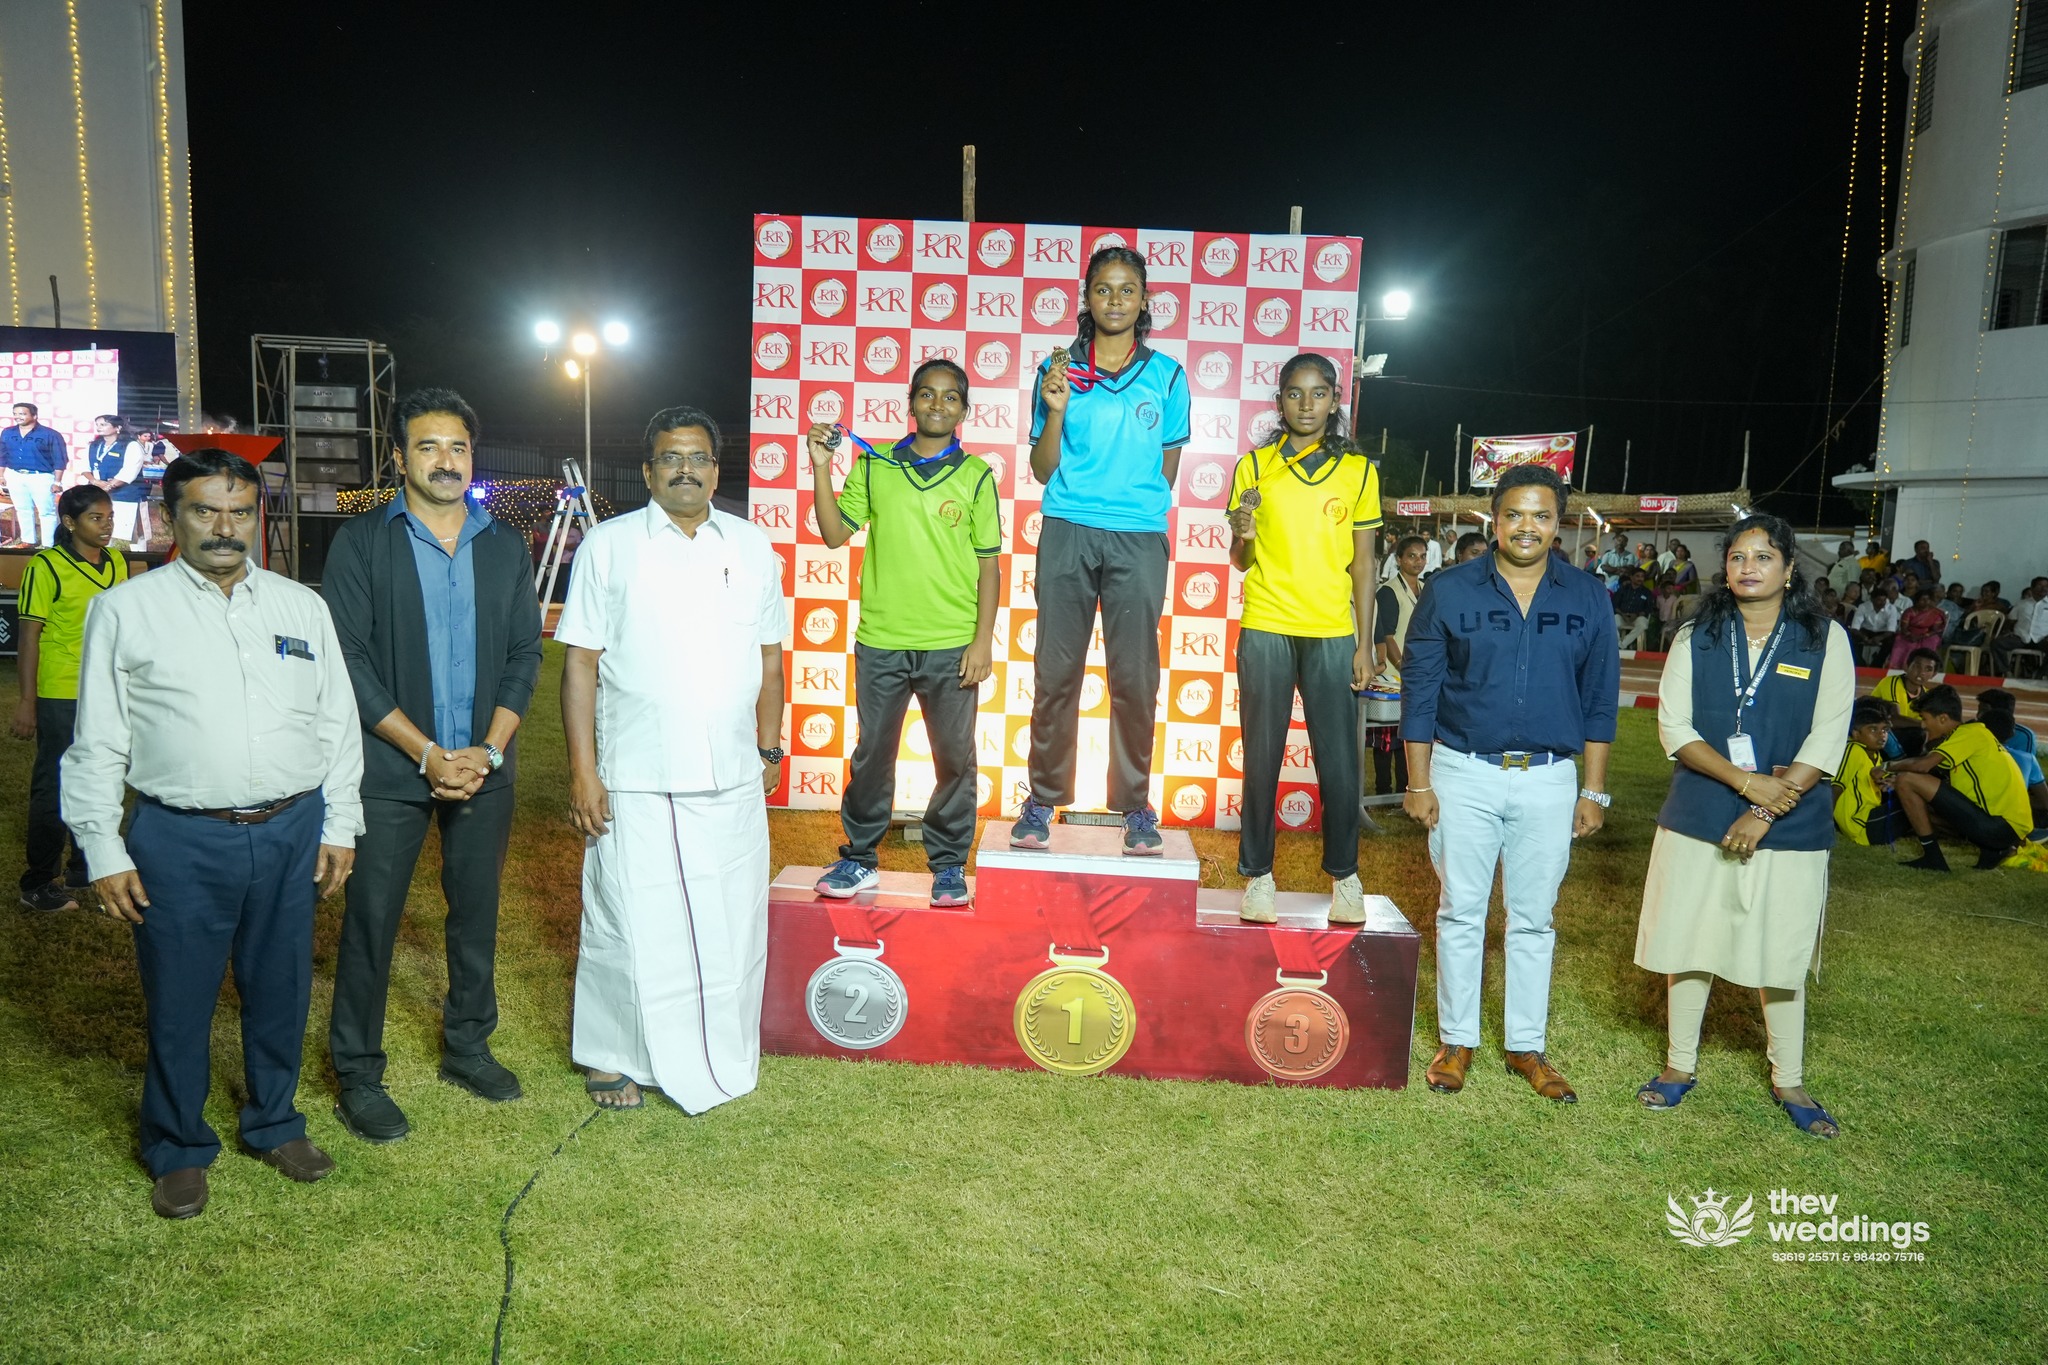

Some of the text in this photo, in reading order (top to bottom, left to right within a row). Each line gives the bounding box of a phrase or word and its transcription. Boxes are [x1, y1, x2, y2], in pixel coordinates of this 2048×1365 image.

[763, 231, 785, 243] RR
[806, 228, 854, 255] RR
[873, 234, 895, 247] RR
[916, 233, 965, 259] RR
[985, 239, 1007, 251] RR
[1028, 237, 1077, 263] RR
[1145, 241, 1189, 267] RR
[1208, 248, 1232, 260] RR
[1251, 246, 1301, 273] RR
[1321, 253, 1344, 265] RR
[754, 282, 798, 308] RR
[817, 289, 839, 301] RR
[860, 287, 908, 313] RR
[928, 293, 949, 306] RR
[970, 291, 1019, 317] RR
[1038, 297, 1060, 310] RR
[1192, 301, 1241, 327] RR
[1261, 308, 1283, 320] RR
[1303, 306, 1353, 333] RR
[762, 342, 783, 354] RR
[804, 340, 852, 366] RR
[871, 347, 893, 359] RR
[1244, 360, 1282, 385] R
[752, 394, 795, 419] RR
[857, 398, 904, 424] RR
[966, 403, 1015, 429] RR
[750, 503, 793, 528] RR
[1400, 503, 1430, 512] CASHIER
[1180, 523, 1229, 549] RR
[798, 559, 845, 585] RR
[1174, 632, 1222, 657] RR
[795, 666, 841, 691] RR
[1170, 738, 1215, 763] RR
[792, 771, 839, 795] RR
[1219, 793, 1243, 817] R
[844, 983, 869, 1024] 2
[1061, 998, 1083, 1045] 1
[1284, 1013, 1310, 1054] 3
